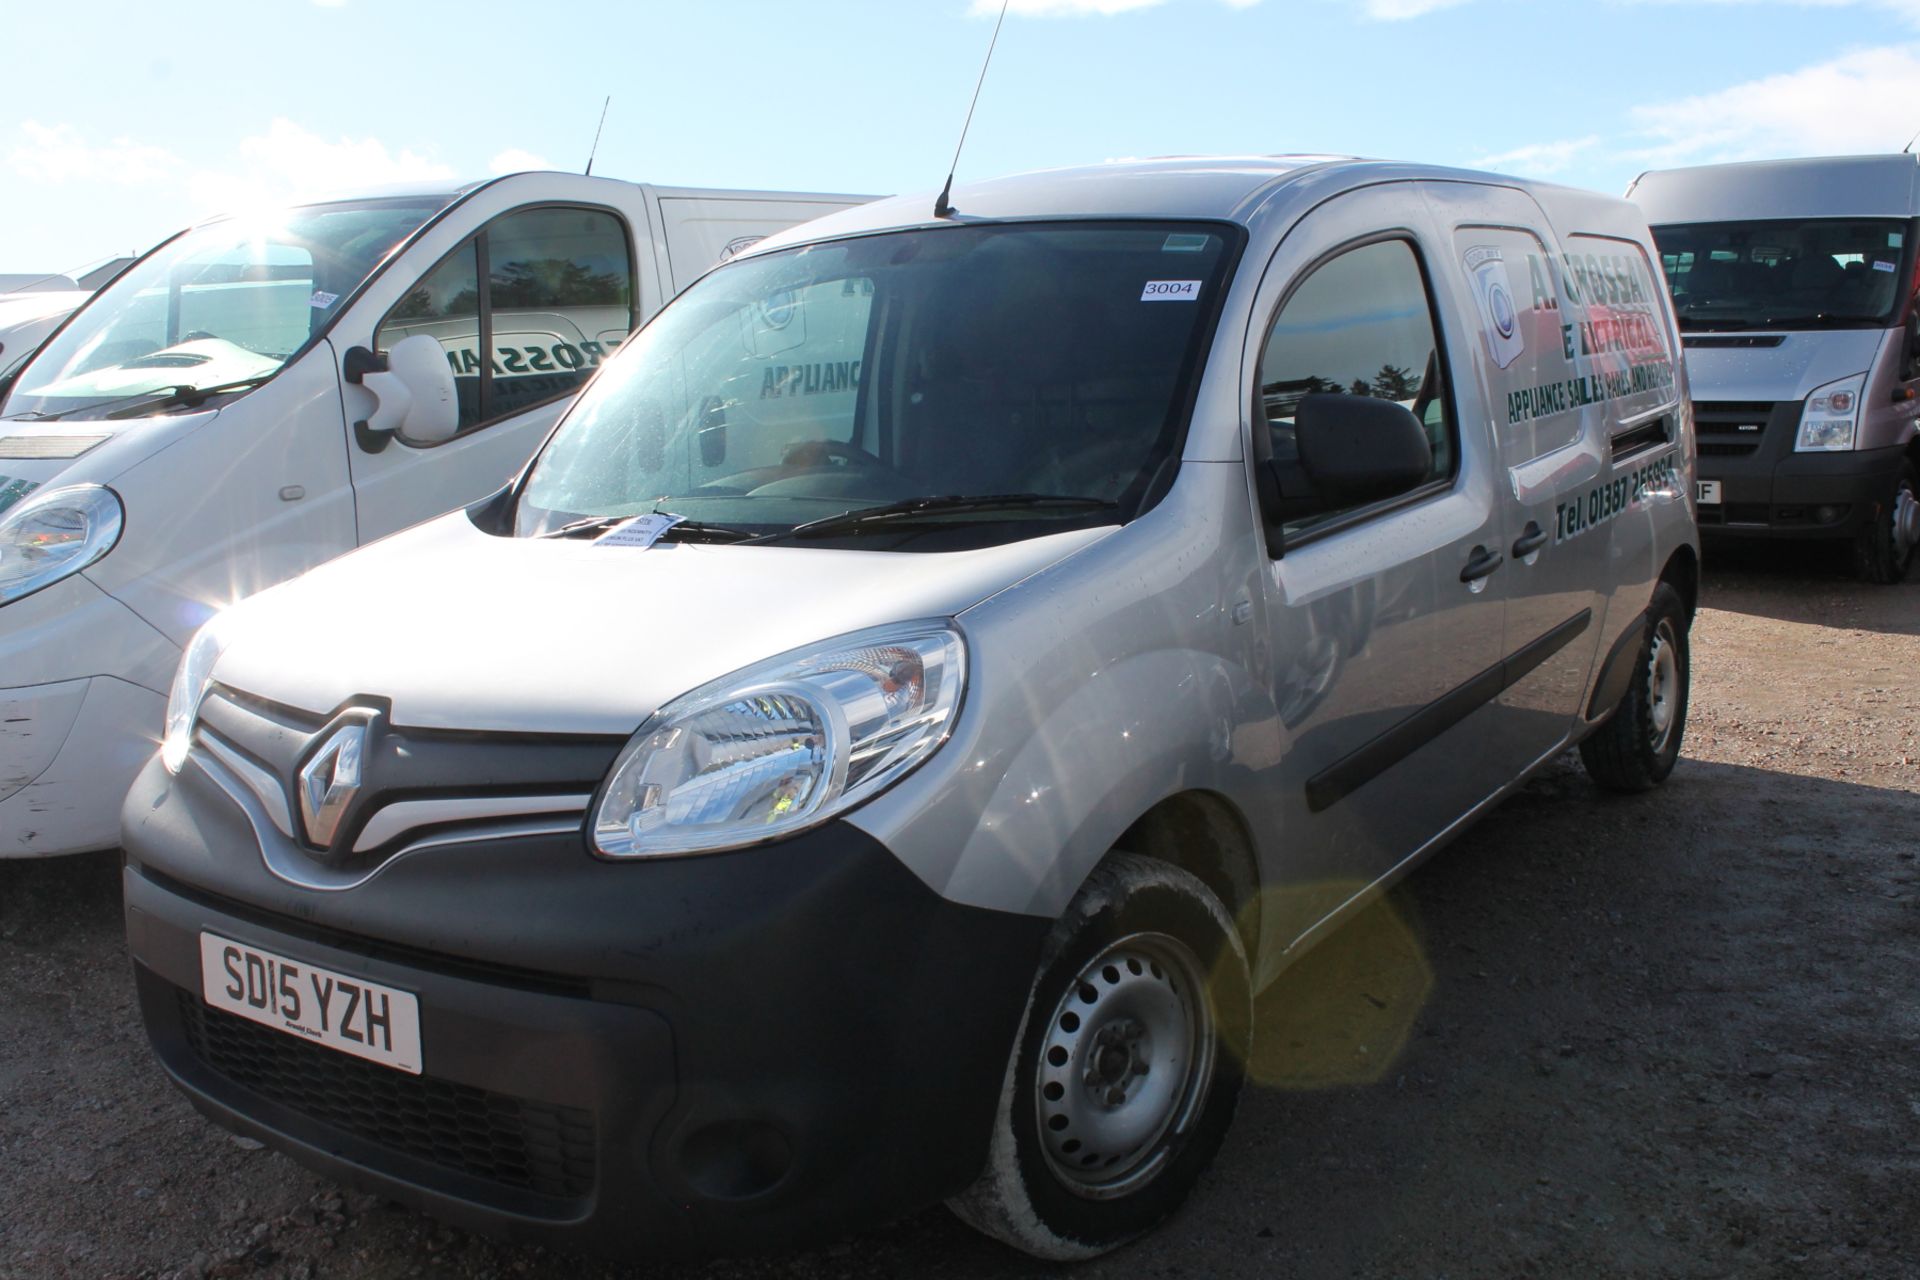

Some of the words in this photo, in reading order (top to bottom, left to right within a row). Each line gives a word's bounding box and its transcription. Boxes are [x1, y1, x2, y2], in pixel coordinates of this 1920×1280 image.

[1145, 283, 1193, 294] 3004
[1508, 382, 1566, 424] APPLIANCE
[1556, 497, 1585, 540] Tel.
[1588, 476, 1628, 525] 01387
[224, 946, 301, 1021] SD15
[311, 973, 392, 1052] YZH
